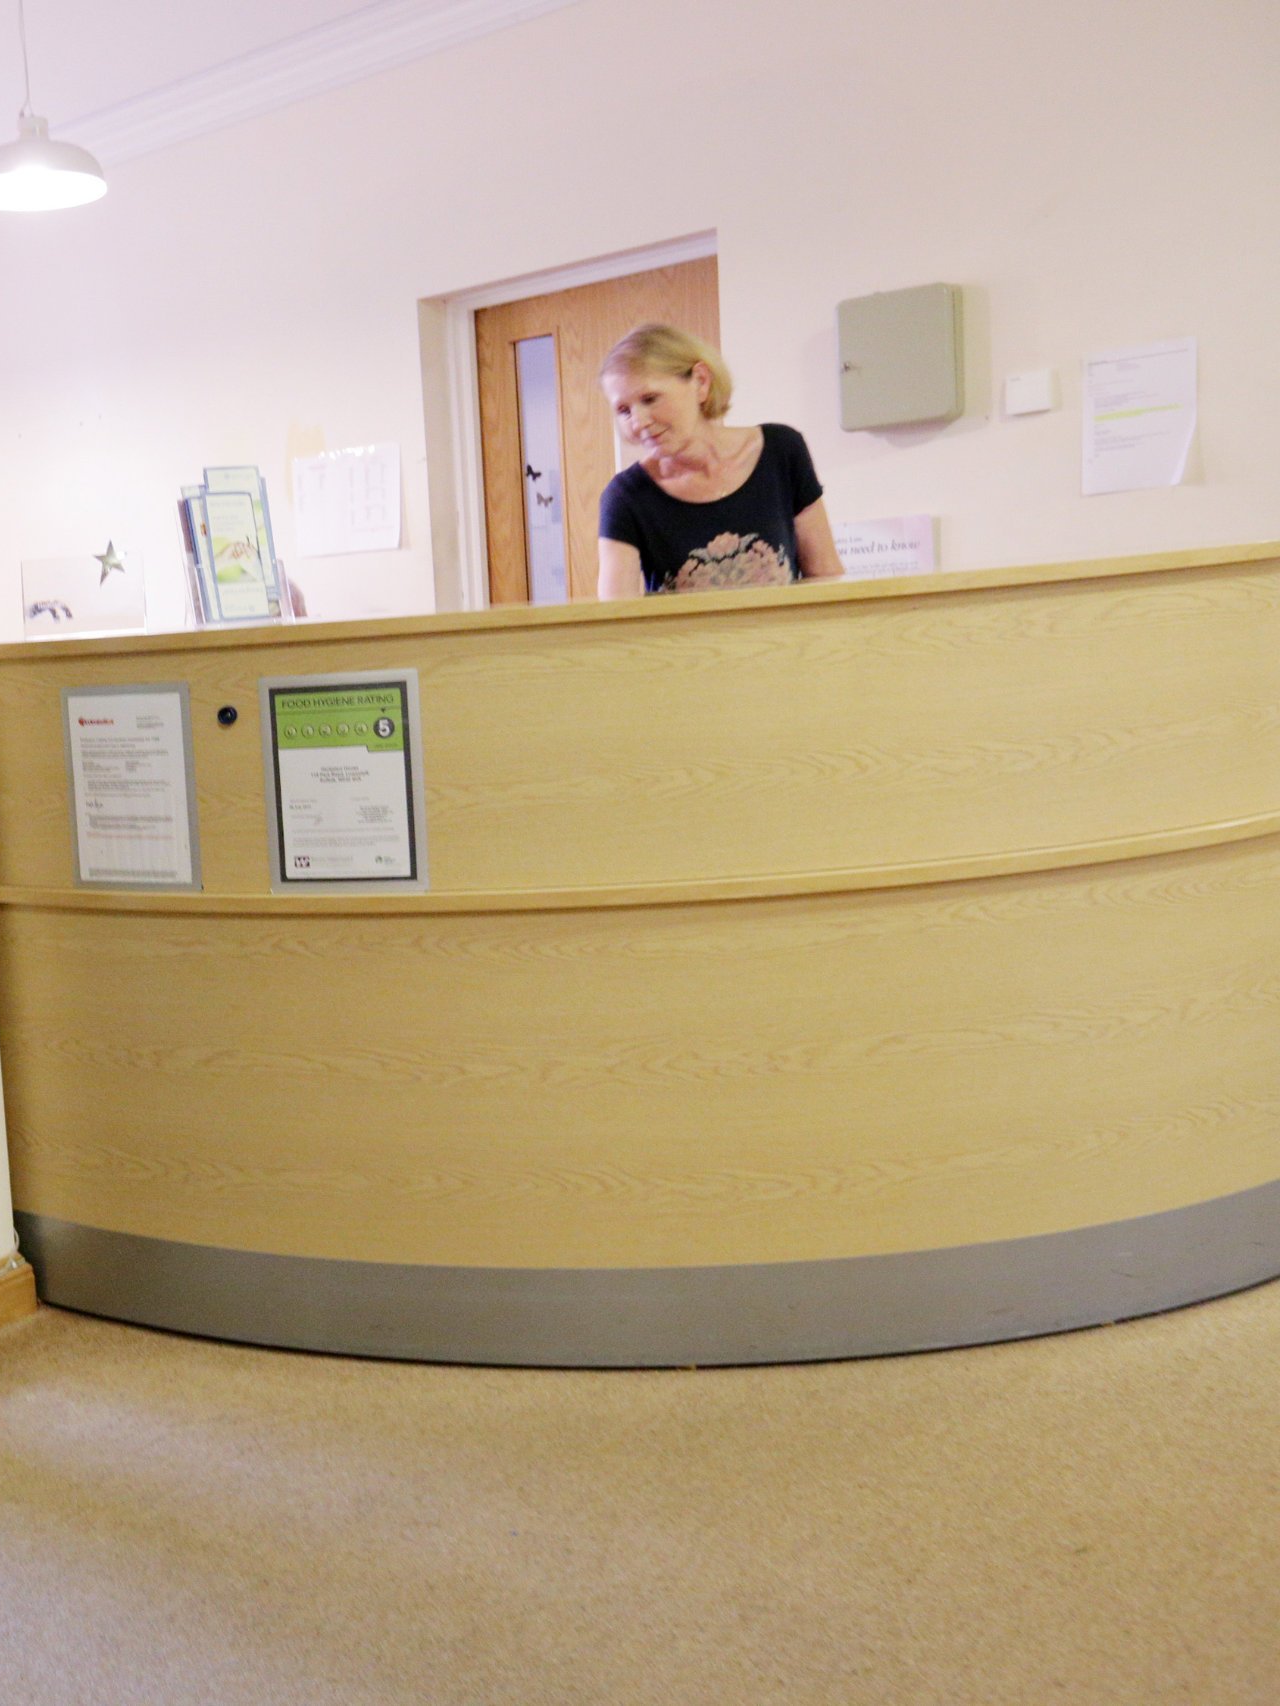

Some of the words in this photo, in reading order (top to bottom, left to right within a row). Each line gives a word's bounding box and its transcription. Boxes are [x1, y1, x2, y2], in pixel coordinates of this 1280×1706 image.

[281, 699, 312, 710] FOOD
[313, 697, 354, 708] HYGIENE
[357, 694, 395, 705] RATING
[378, 719, 391, 737] 5
